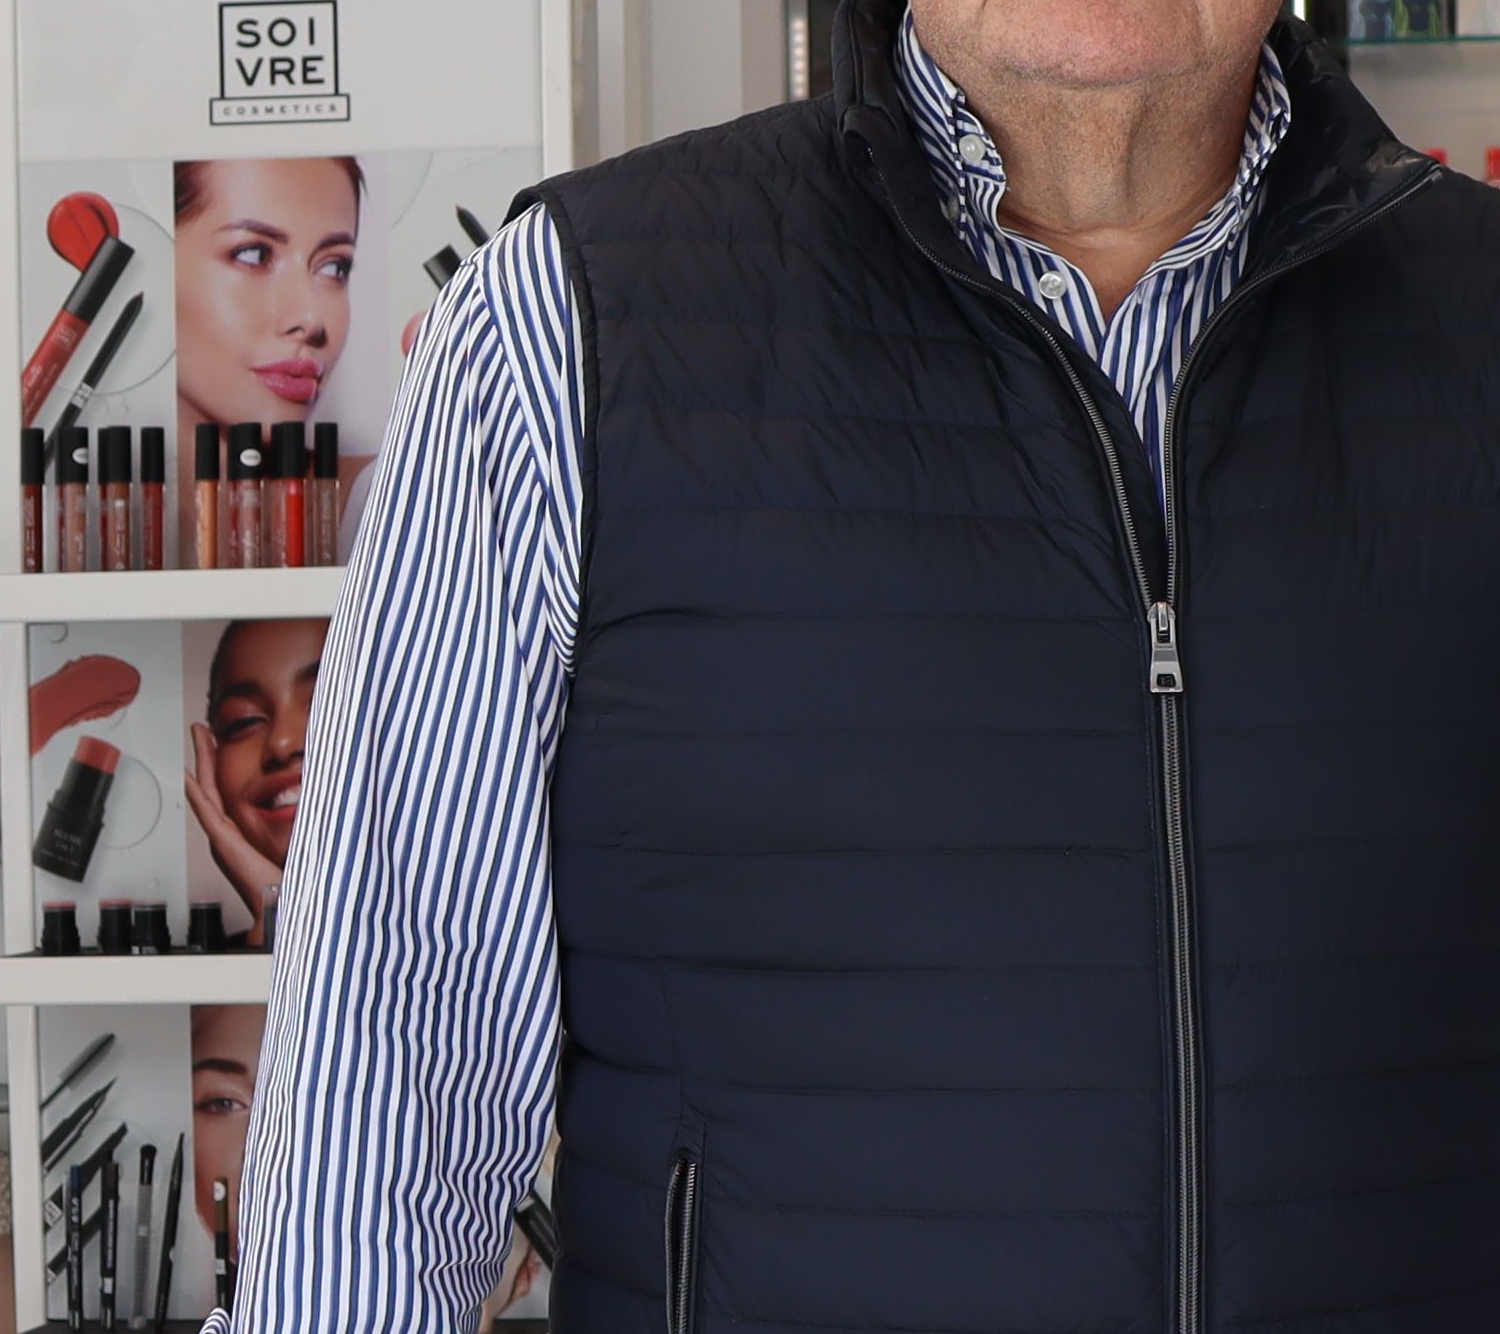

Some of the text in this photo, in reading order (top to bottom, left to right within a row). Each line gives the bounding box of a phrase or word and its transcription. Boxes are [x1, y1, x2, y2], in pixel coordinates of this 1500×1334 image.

[235, 16, 316, 48] SOI
[235, 53, 326, 86] VRE
[222, 101, 339, 118] COSMETICS
